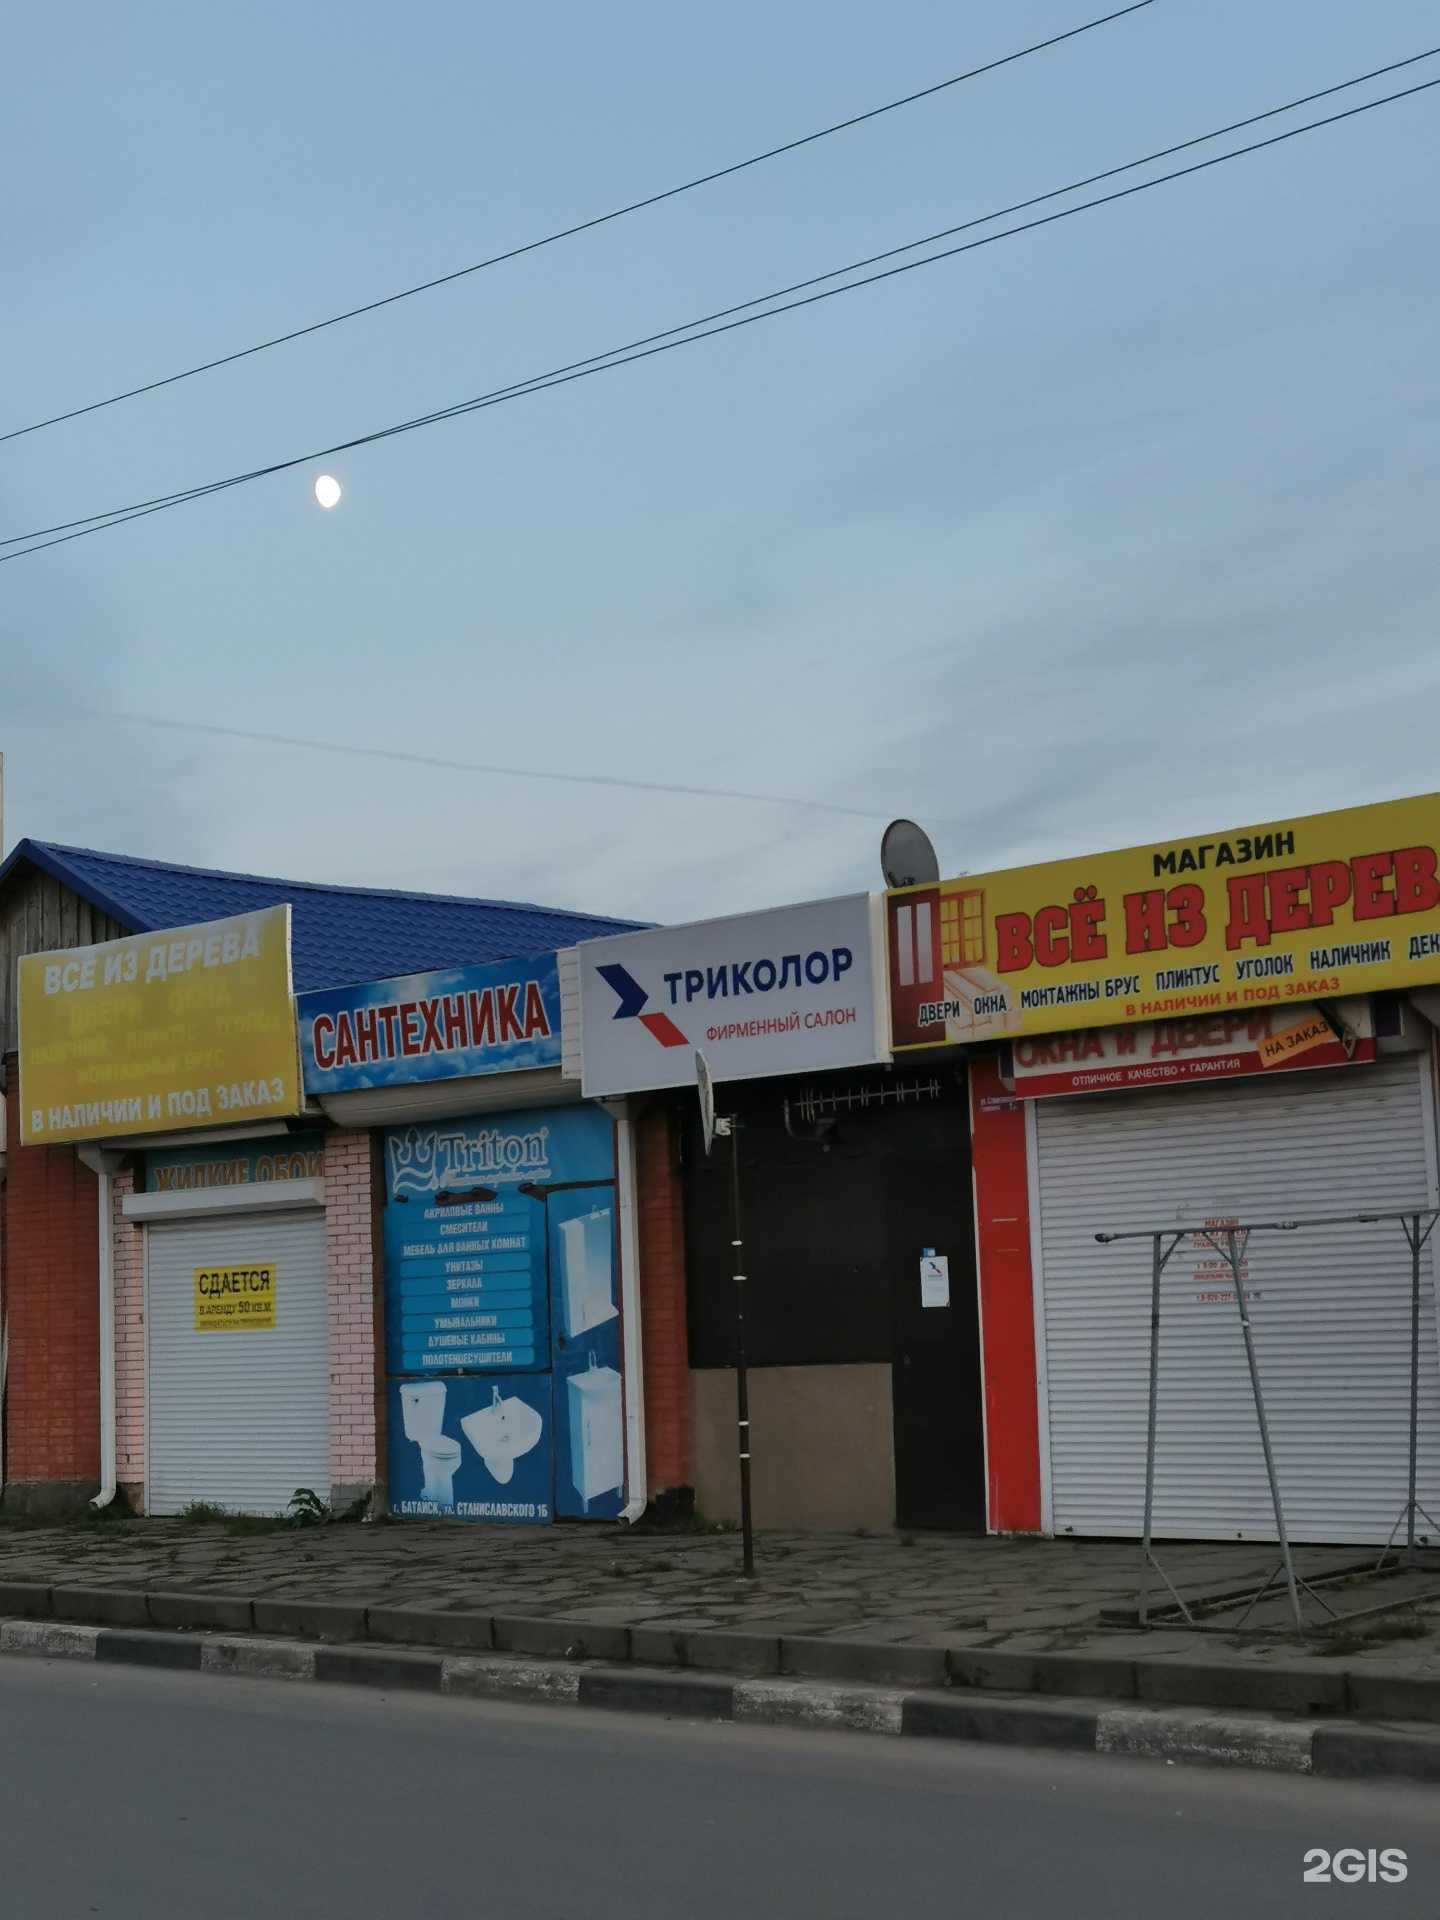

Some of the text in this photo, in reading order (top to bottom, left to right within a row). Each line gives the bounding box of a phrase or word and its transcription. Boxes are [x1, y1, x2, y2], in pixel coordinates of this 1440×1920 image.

[1153, 831, 1296, 877] МАГАЗИН
[995, 846, 1440, 974] ВСЁ ИЗ ДЕРЕВ
[103, 951, 138, 985] ИЗ
[145, 929, 261, 985] ДЕРЕВА
[663, 947, 854, 1005] ТРИКОЛОР
[919, 1001, 961, 1028] ДВЕРИ
[973, 994, 1008, 1015] ОКНА
[1020, 980, 1101, 1009] МОНТАЖНЫ
[1105, 975, 1141, 998] БРУС
[1155, 964, 1221, 991] ПЛИНТУС
[1236, 954, 1294, 981] УГОЛОК
[1310, 940, 1392, 971] НАЛИЧНИК
[1125, 977, 1341, 1016] В НАЛИЧИИ И ПОД ЗАКАЗ
[312, 980, 552, 1071] САНТЕХНИКА
[706, 1008, 857, 1042] ФИРМЕННЫЙ САЛОН
[1015, 1026, 1106, 1068] ОКНА
[1150, 1009, 1273, 1059] ДВЕРИ
[1264, 1021, 1330, 1057] НА ЗАКАЗ
[1072, 1071, 1123, 1087] ОТЛИЧНОЕ
[1127, 1065, 1179, 1082] КАЧЕСТВО
[1189, 1058, 1241, 1074] ГАРАНТИЯ
[31, 1077, 286, 1133] В НАЛИЧИИ И ПОД ЗАКАЗ
[437, 1129, 547, 1172] Triton
[440, 1221, 488, 1235] СМЕСИТЕЛИ
[403, 1243, 435, 1256] МЕБЕЛЬ
[445, 1259, 484, 1272] УНИТАЗЫ
[199, 1270, 270, 1299] СДАЕТСЯ
[445, 1277, 482, 1290] ЗЕРКАЛА
[456, 1501, 535, 1518] СТАНИСЛАВСКОГО
